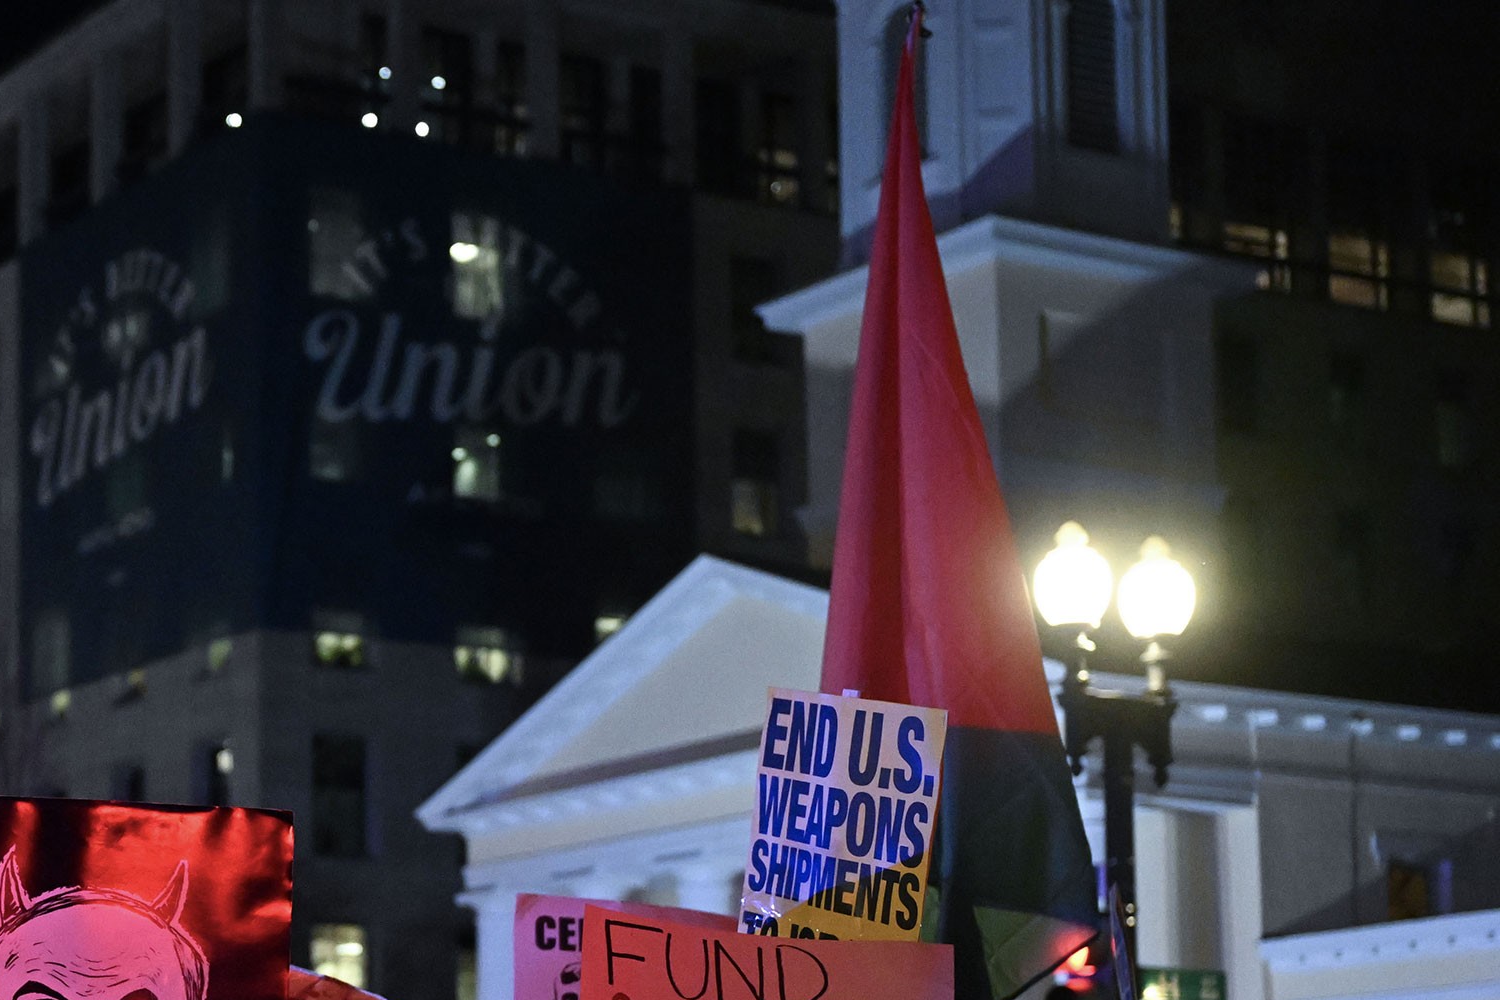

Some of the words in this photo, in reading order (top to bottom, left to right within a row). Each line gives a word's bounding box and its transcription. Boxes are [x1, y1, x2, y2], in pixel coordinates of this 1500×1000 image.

[30, 326, 212, 507] Union
[304, 309, 641, 426] Union
[762, 697, 838, 778] END
[848, 709, 934, 798] U.S.
[758, 773, 929, 869] WEAPONS
[747, 838, 920, 921] SHIPMENTS
